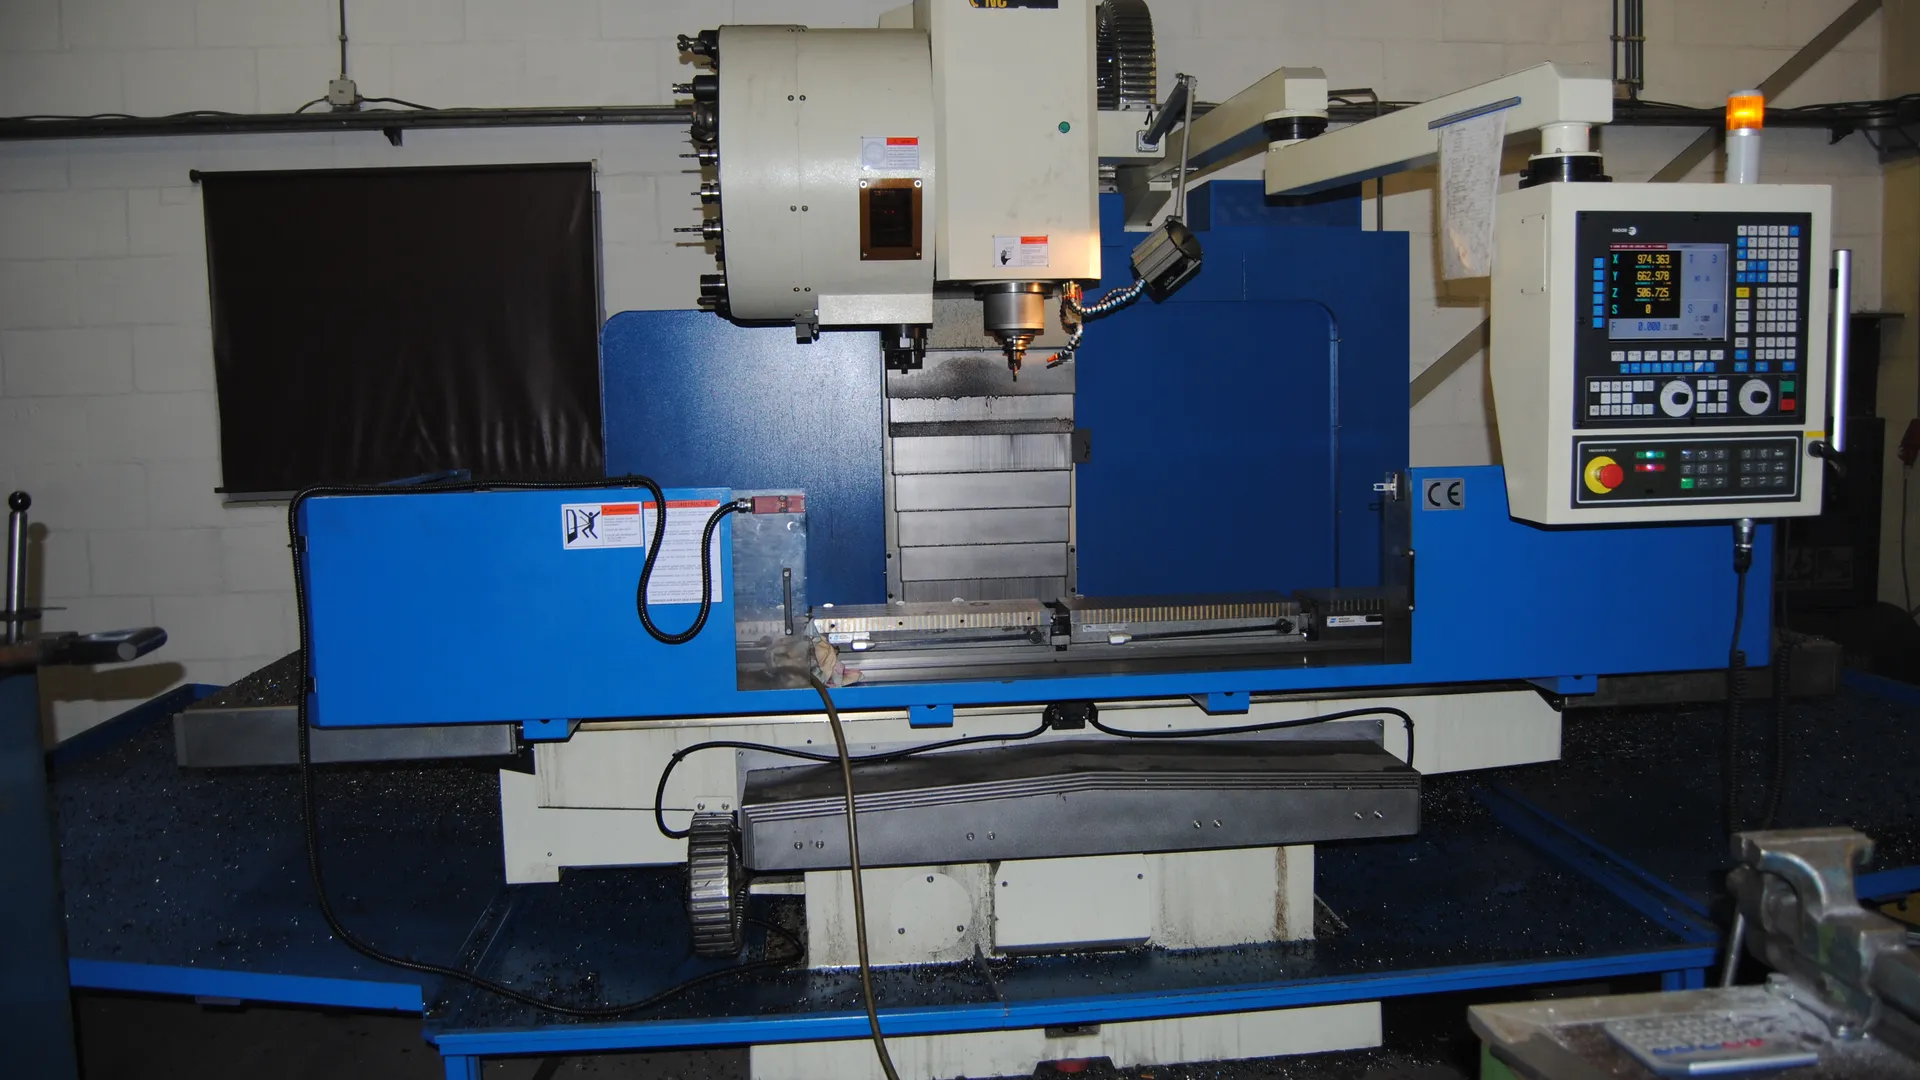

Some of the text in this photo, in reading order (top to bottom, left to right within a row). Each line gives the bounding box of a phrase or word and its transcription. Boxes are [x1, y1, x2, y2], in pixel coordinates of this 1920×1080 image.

[1612, 254, 1670, 264] X 974.363
[1612, 271, 1670, 281] Y 662.978
[1612, 287, 1669, 298] Z 506.725
[1611, 304, 1651, 314] S 0
[1687, 304, 1693, 314] S
[1611, 322, 1617, 331] F
[1637, 321, 1661, 331] 0.000
[1427, 481, 1461, 507] CE
